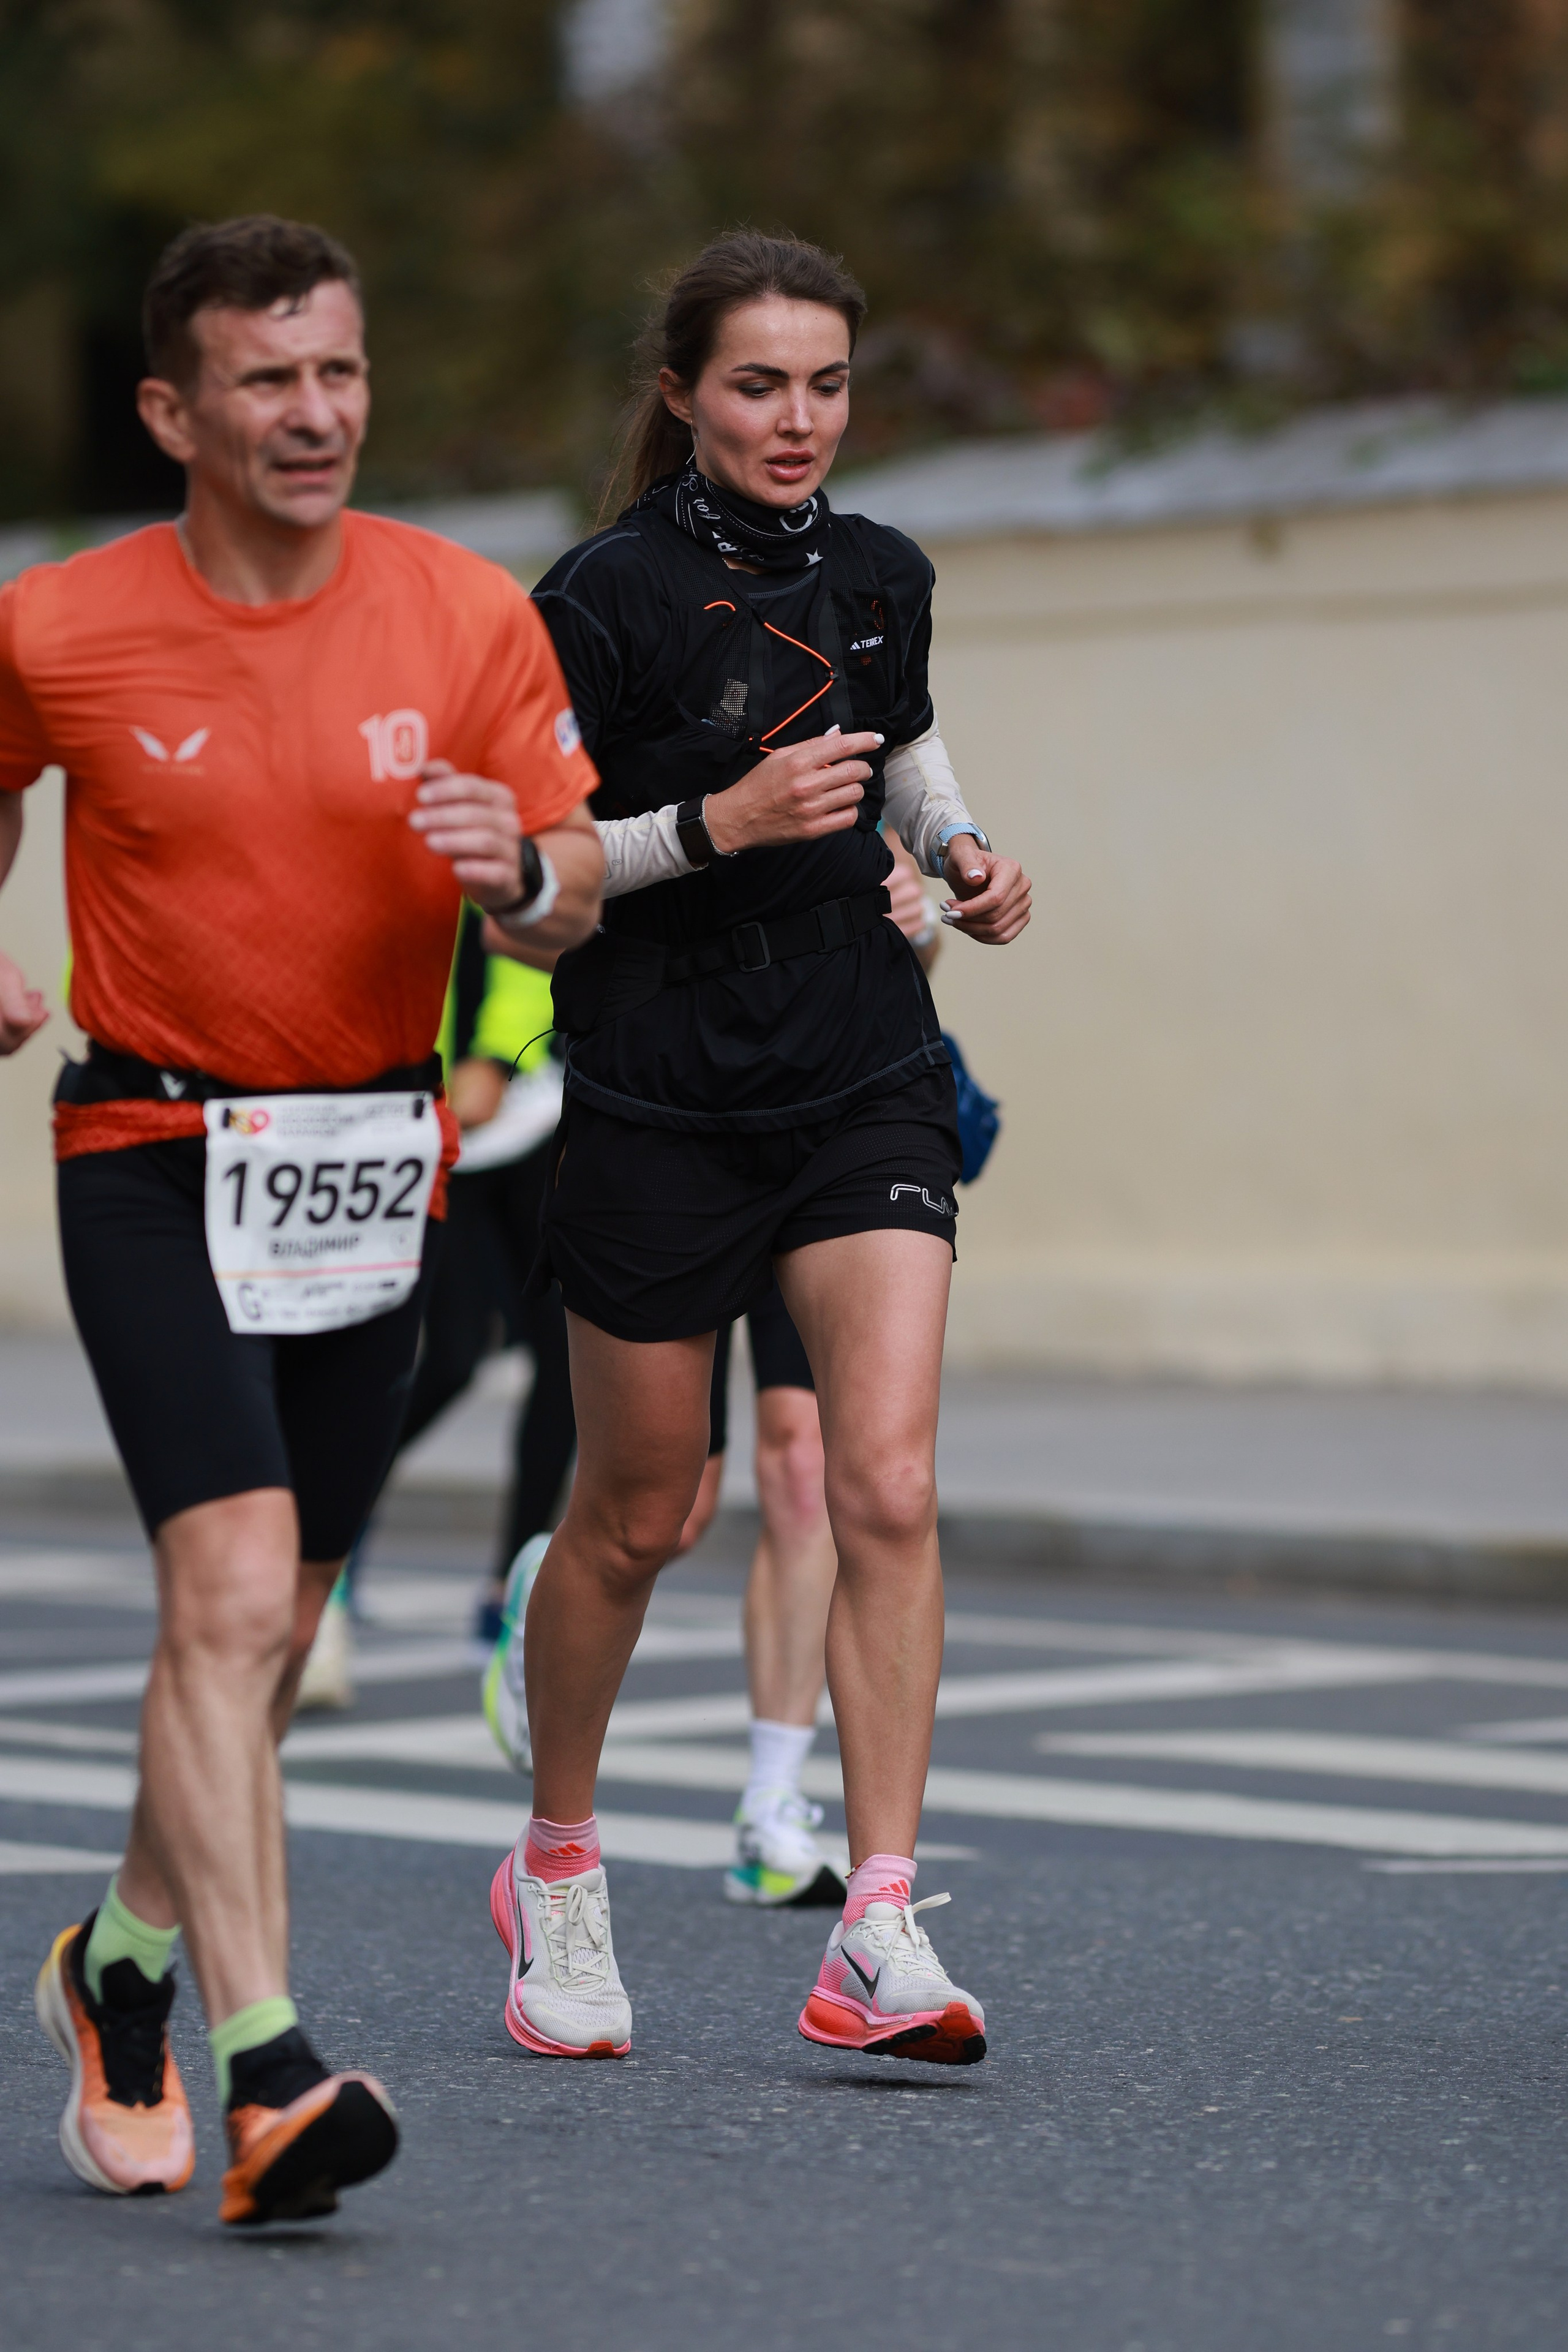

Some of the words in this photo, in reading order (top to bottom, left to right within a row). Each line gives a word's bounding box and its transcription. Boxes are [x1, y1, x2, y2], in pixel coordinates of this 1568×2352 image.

[693, 497, 721, 519] for
[860, 635, 884, 649] TERREX
[358, 709, 428, 782] 10
[222, 1159, 424, 1227] 19552
